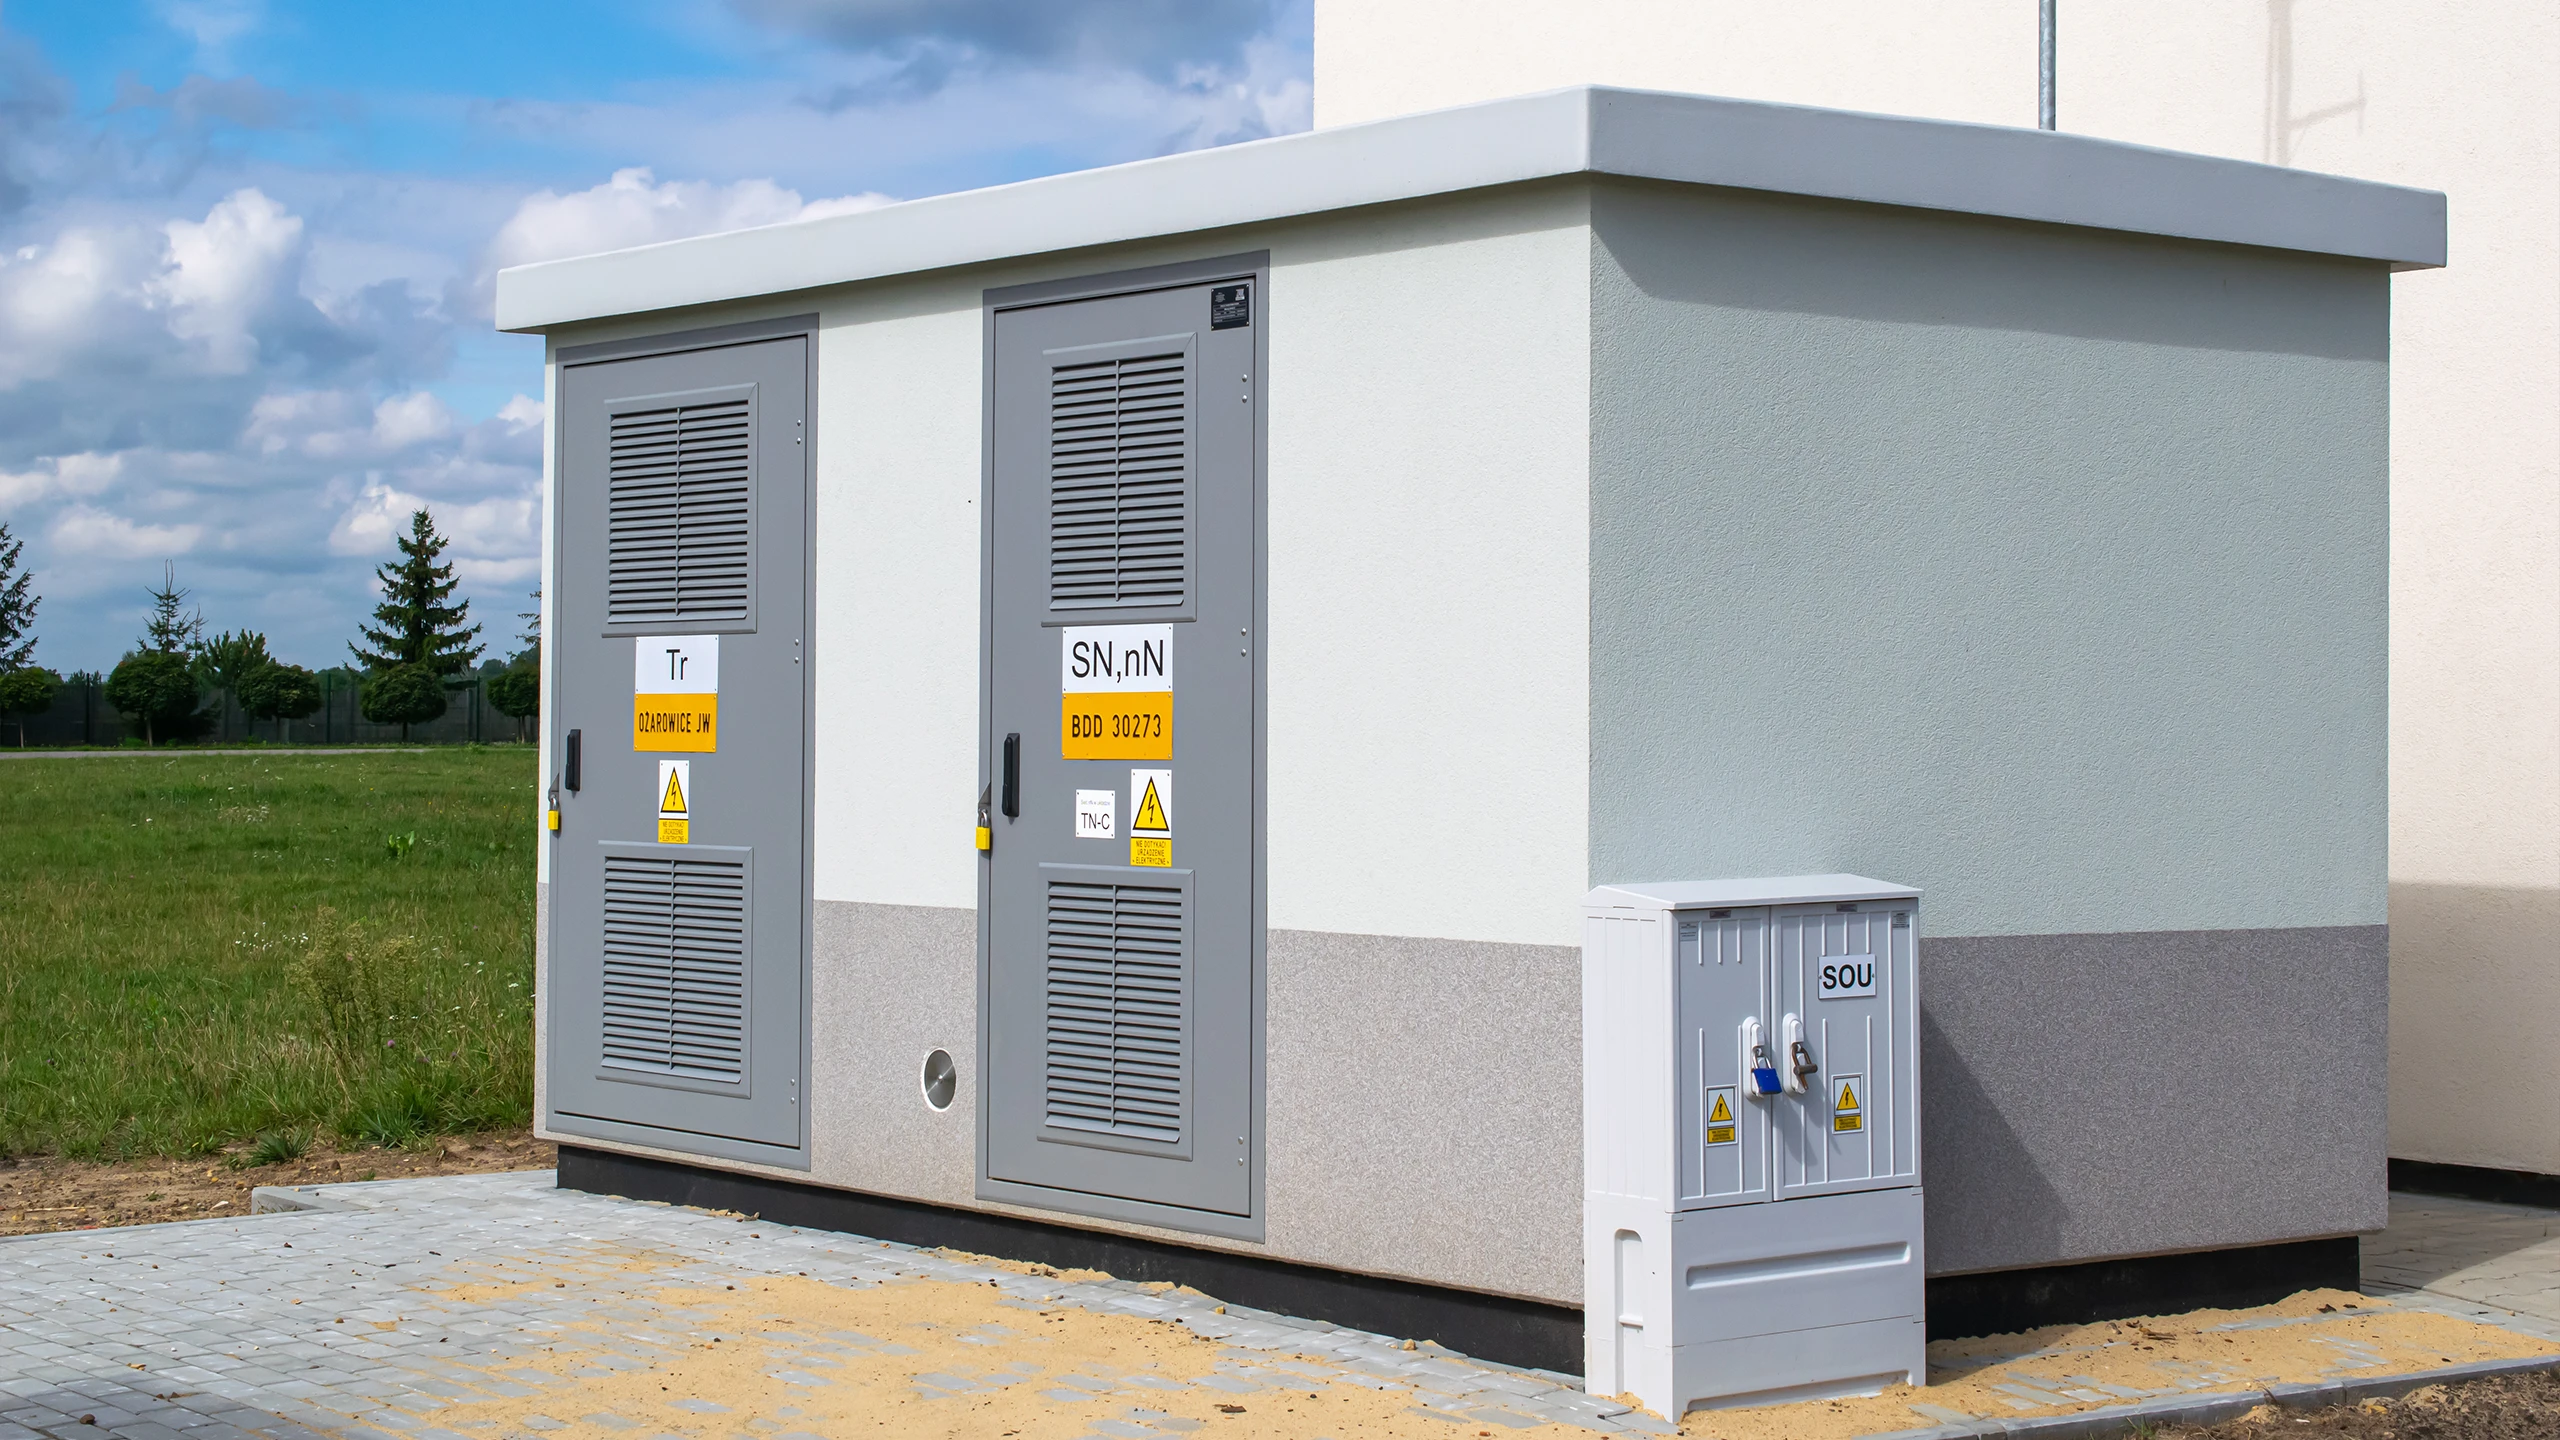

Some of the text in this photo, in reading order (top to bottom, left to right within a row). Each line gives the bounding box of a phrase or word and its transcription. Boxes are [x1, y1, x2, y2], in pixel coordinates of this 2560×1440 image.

[665, 648, 688, 681] Tr
[1071, 639, 1164, 683] SN,nN
[638, 711, 711, 733] OŻAROWICE JW
[1071, 713, 1162, 738] BDD 30273
[1080, 812, 1111, 831] TN-C
[1822, 963, 1872, 990] SOU
